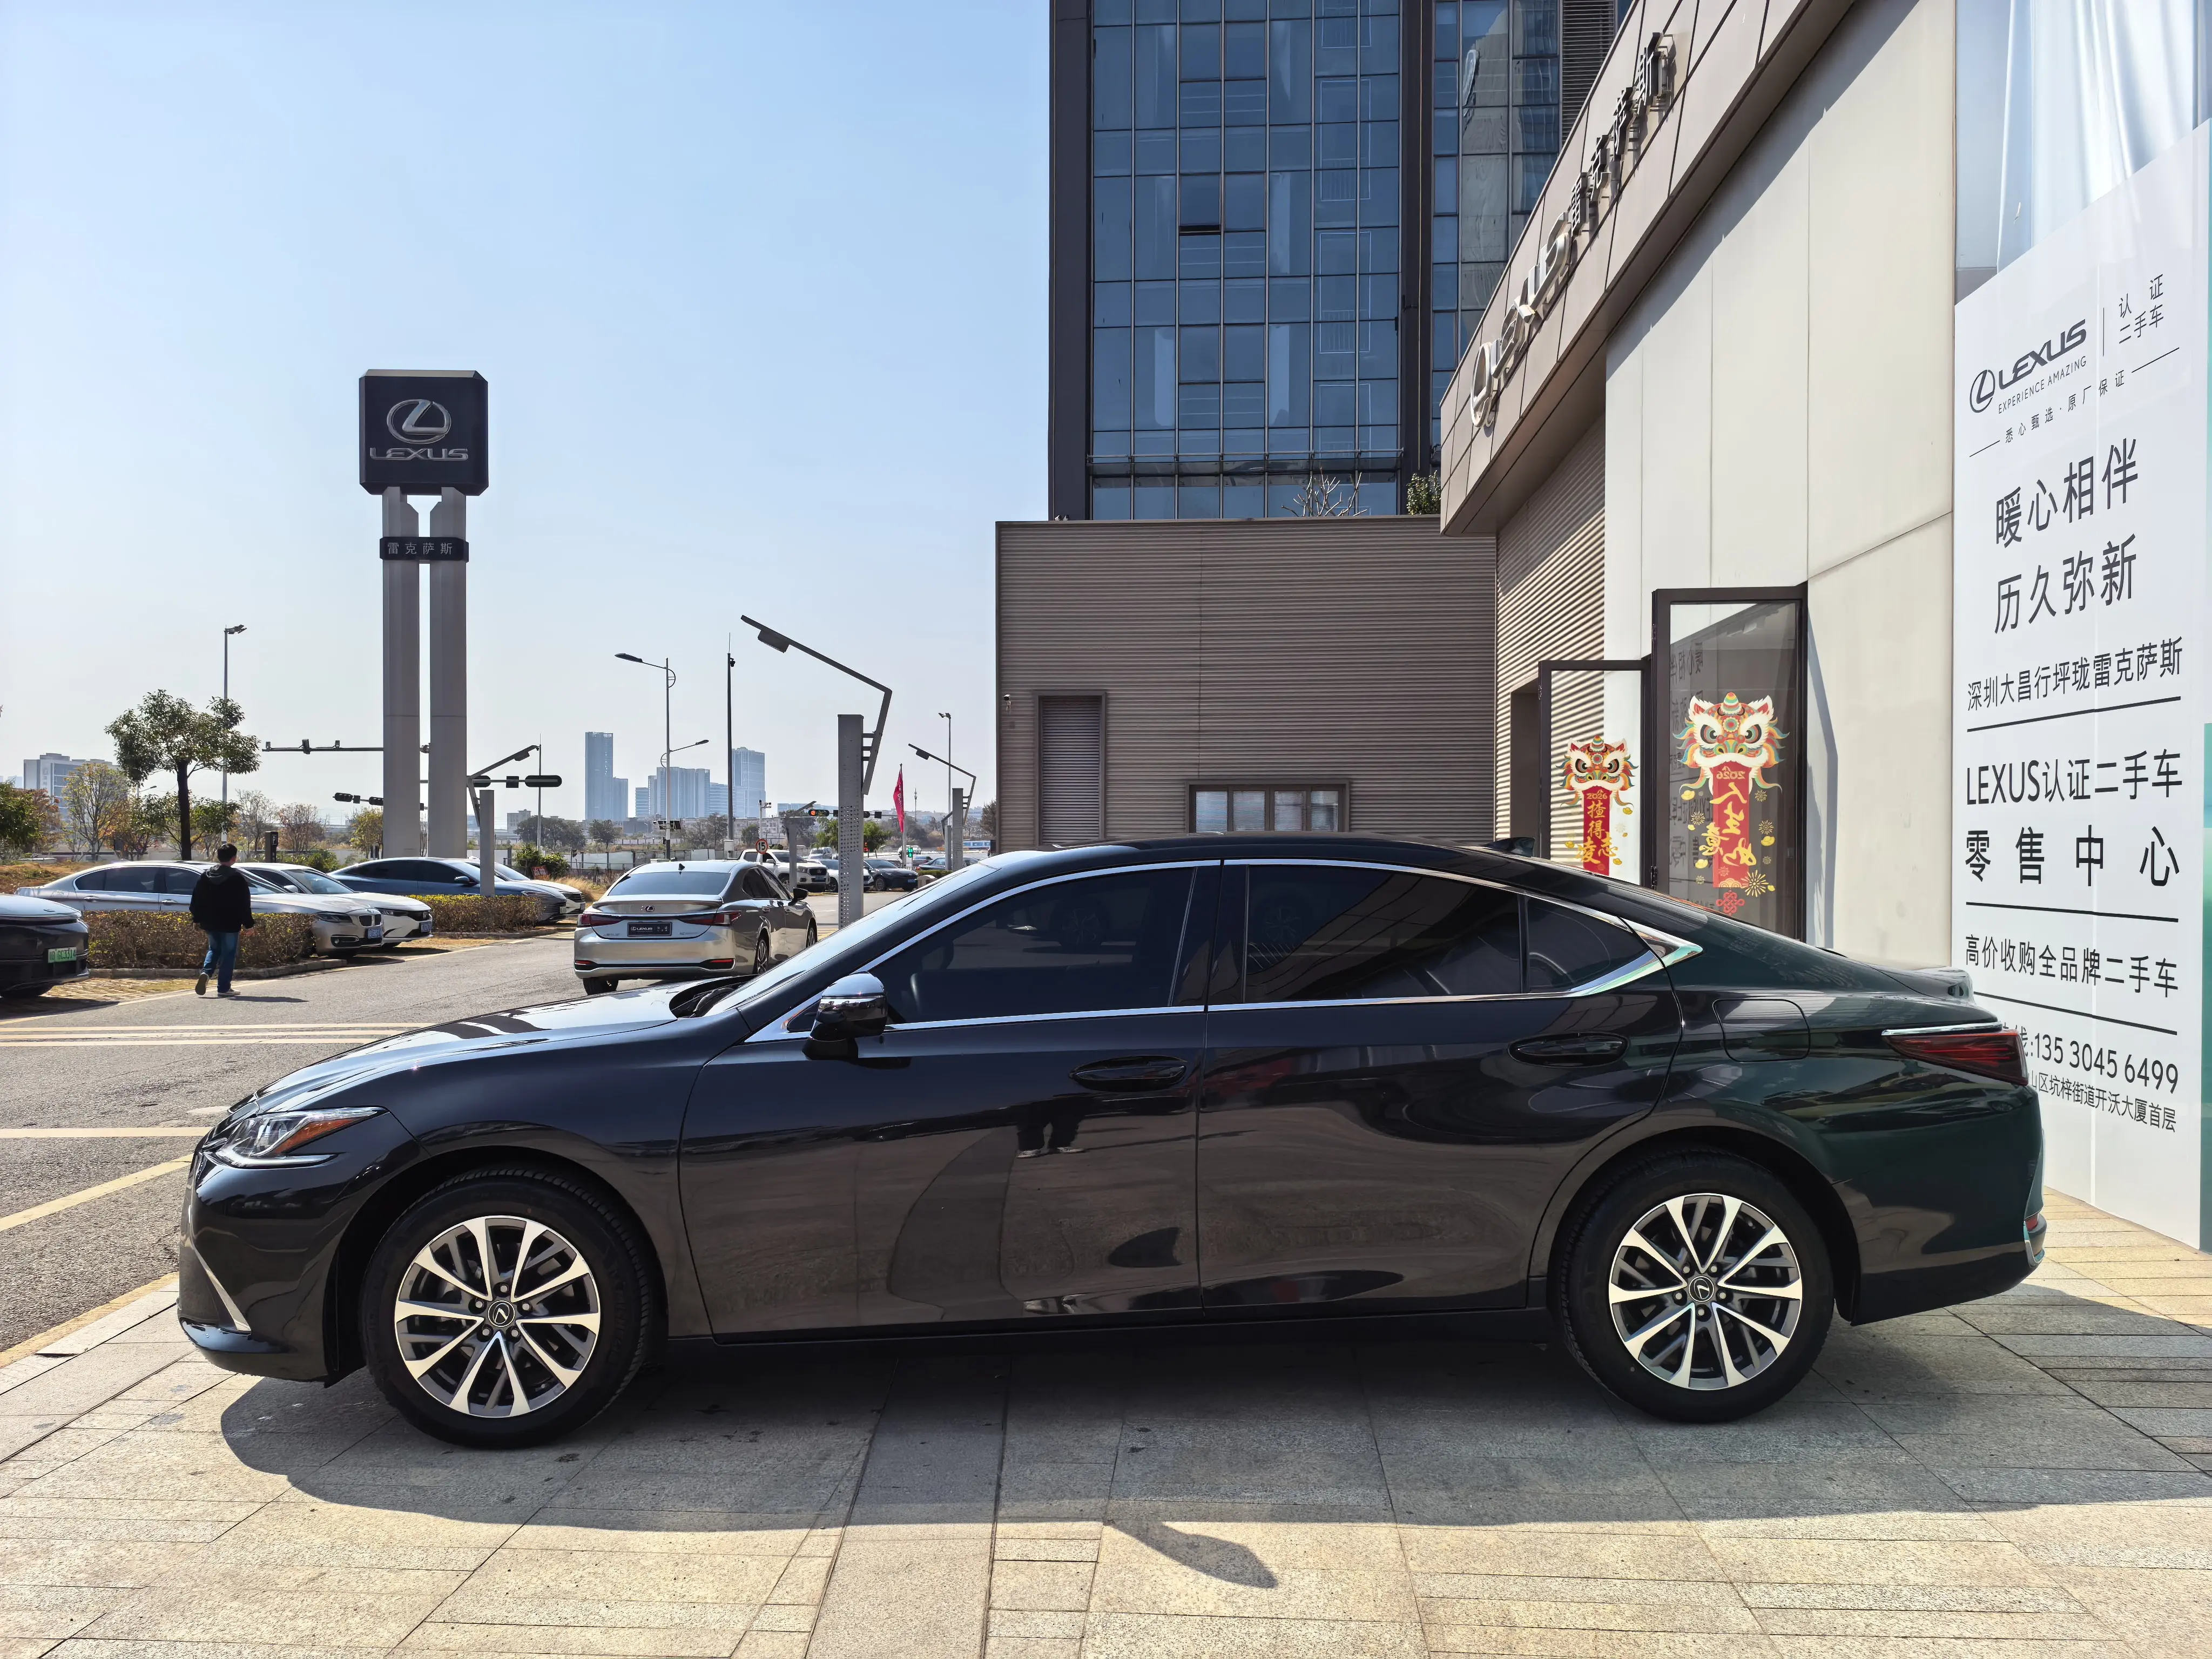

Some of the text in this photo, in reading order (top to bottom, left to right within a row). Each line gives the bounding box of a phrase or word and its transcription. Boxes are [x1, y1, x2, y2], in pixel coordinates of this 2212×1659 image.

[1490, 211, 1570, 379] LEXUS
[2119, 274, 2163, 318] 认证
[2119, 304, 2164, 343] 二手车
[1998, 319, 2087, 389] LEXUS
[1998, 356, 2087, 414] EXPERIENCE AMAZING
[370, 447, 469, 461] LEXUS
[1995, 437, 2138, 548] 暖心相伴
[387, 542, 453, 555] 雷克萨斯
[1994, 533, 2136, 634] 历久弥新
[1967, 636, 2183, 712] 深圳大昌行坪珑雷克萨斯
[1967, 748, 2182, 805] LEXUS认证二手车
[758, 842, 766, 851] 15
[1965, 824, 2180, 887] 零售中心
[1965, 934, 2179, 998] 高价收购全品牌二手车
[2069, 1040, 2118, 1078] 3045
[2124, 1054, 2179, 1094] 6499
